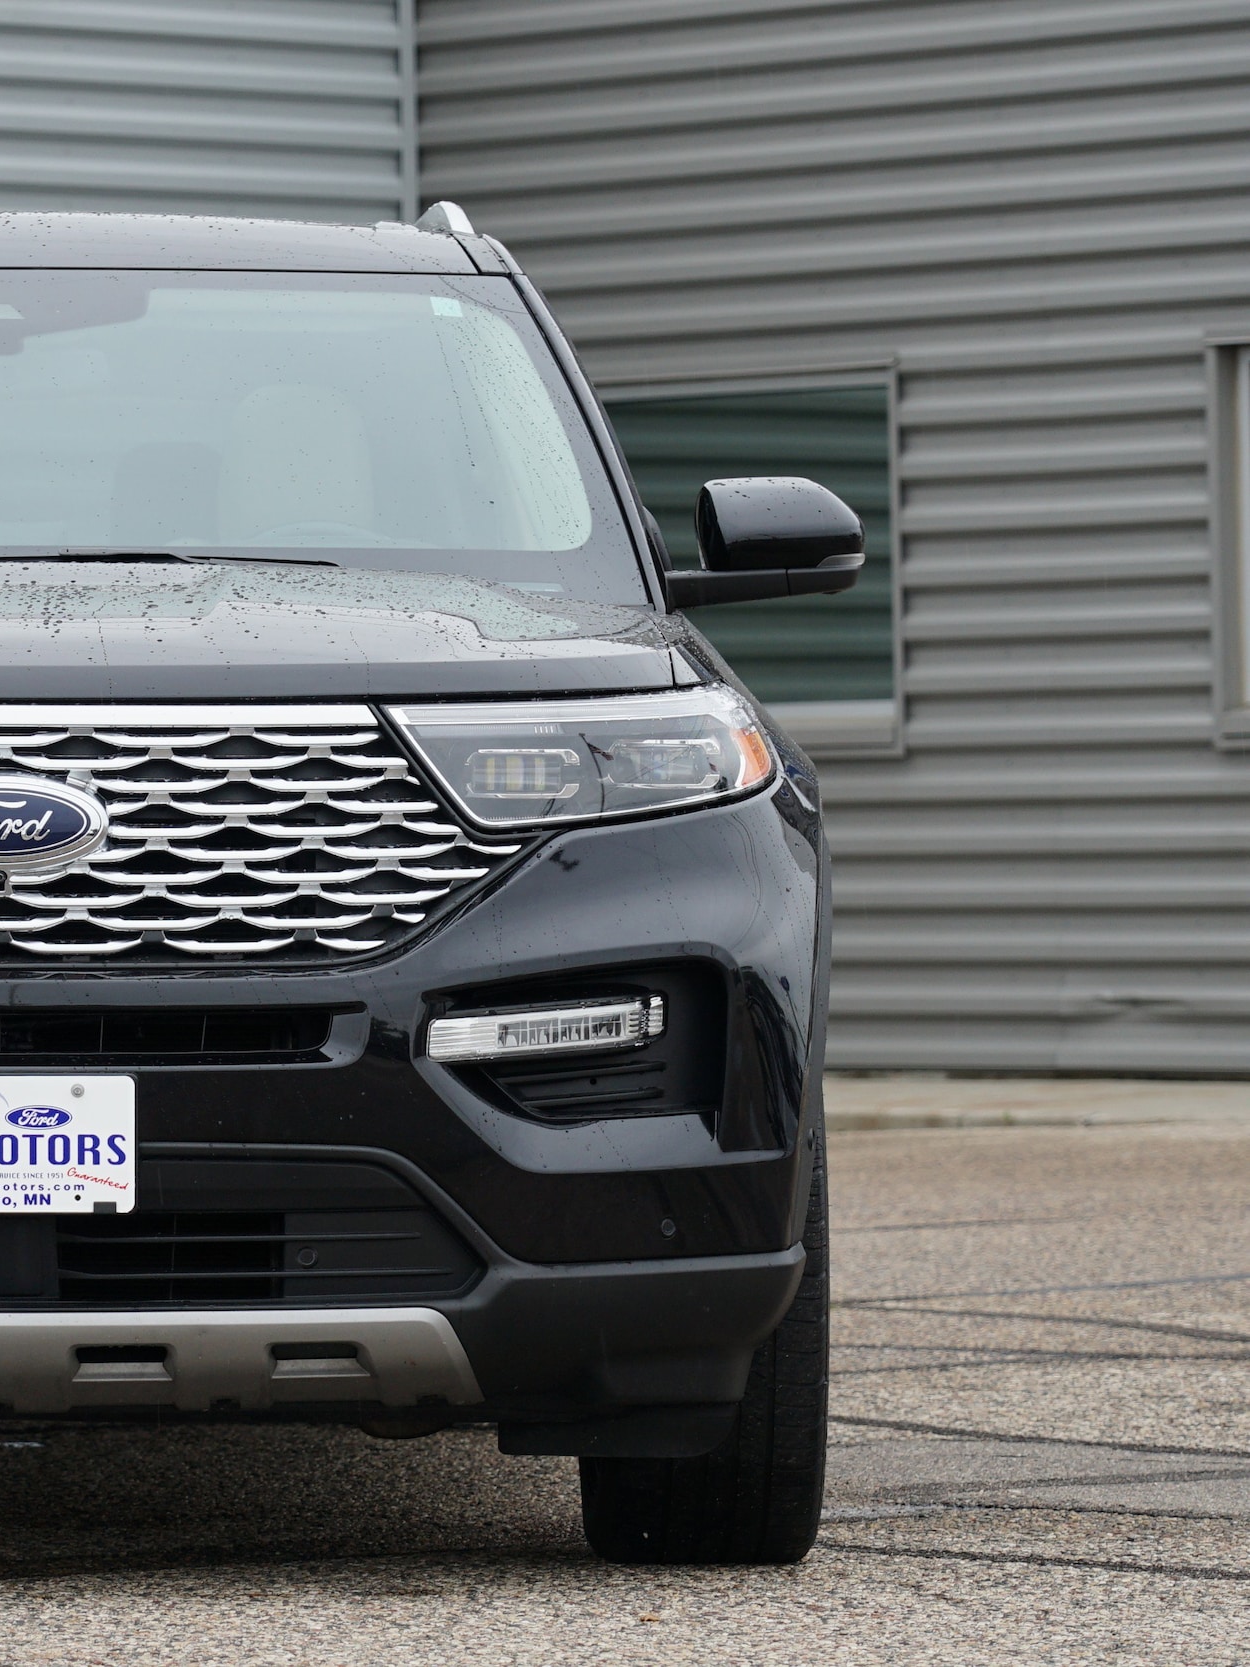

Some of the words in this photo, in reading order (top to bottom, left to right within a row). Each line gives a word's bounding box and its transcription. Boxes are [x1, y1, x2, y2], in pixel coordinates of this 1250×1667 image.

[18, 1108, 59, 1126] Ford
[66, 1166, 129, 1191] Guaranteed
[23, 1193, 51, 1206] MN
